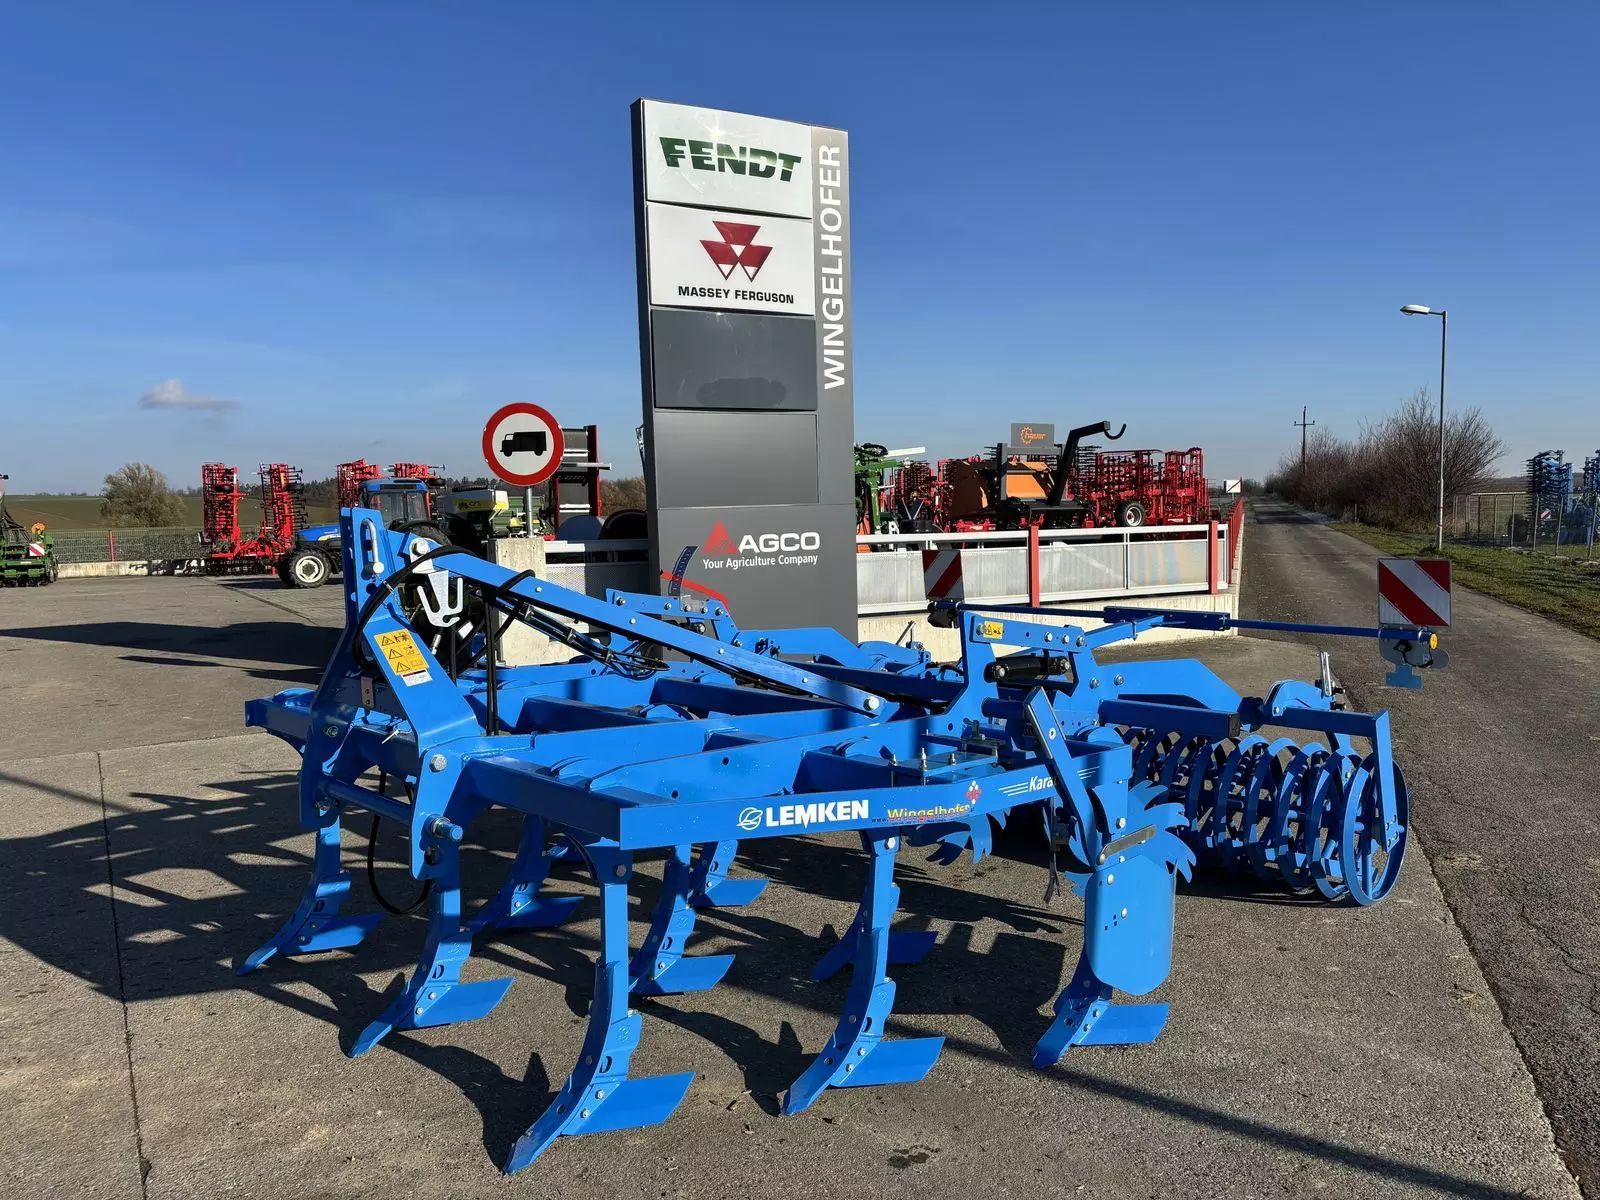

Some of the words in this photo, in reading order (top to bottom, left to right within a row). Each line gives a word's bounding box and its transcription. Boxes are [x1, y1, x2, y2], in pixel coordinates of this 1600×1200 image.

[659, 136, 802, 182] FENDT
[819, 143, 845, 390] WINGELHOFER
[678, 285, 730, 299] MASSEY
[734, 289, 794, 304] FERGUSON
[738, 531, 820, 553] AGCO
[703, 559, 723, 569] Your
[726, 556, 776, 570] Agriculture
[778, 554, 818, 567] Company
[1029, 775, 1056, 793] Kara
[766, 799, 869, 828] LEMKEN
